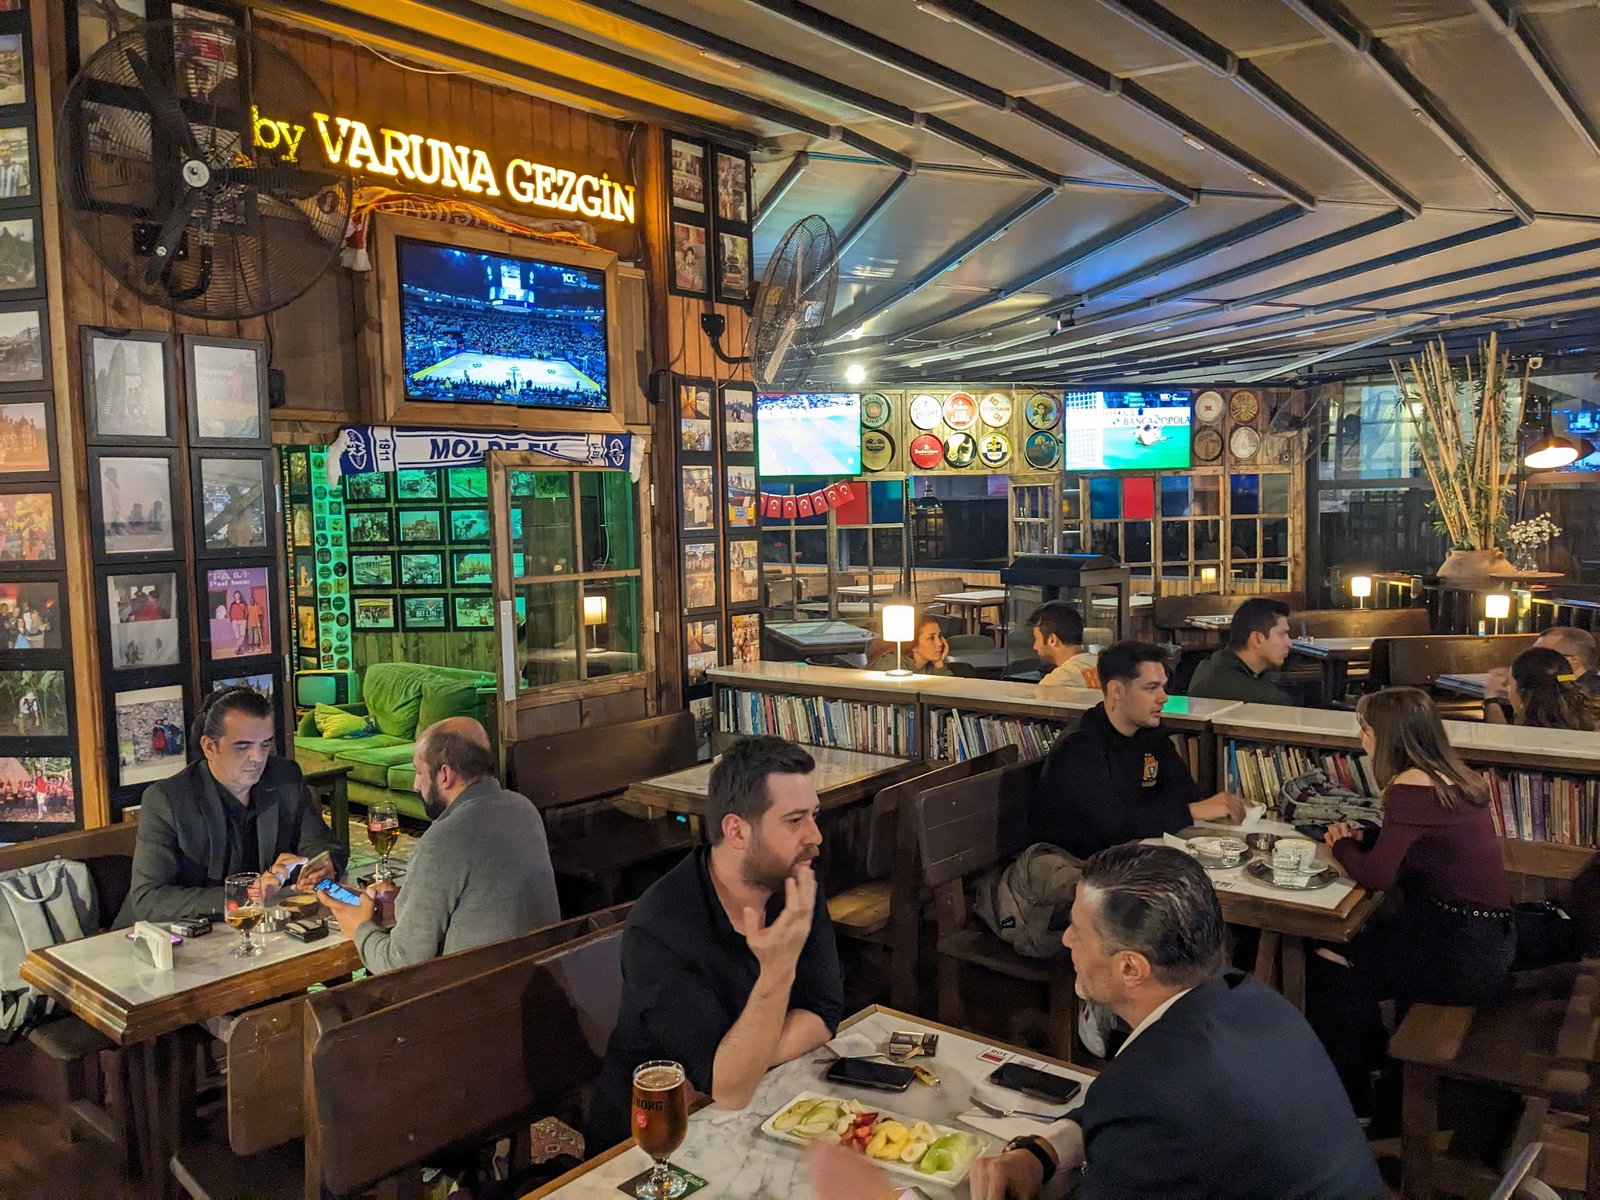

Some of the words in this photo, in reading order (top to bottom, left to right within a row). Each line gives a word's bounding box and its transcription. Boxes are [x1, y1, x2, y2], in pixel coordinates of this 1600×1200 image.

[252, 104, 305, 162] by
[312, 112, 501, 197] VARUNA
[506, 158, 636, 224] GEZGİN
[379, 438, 391, 461] 1911
